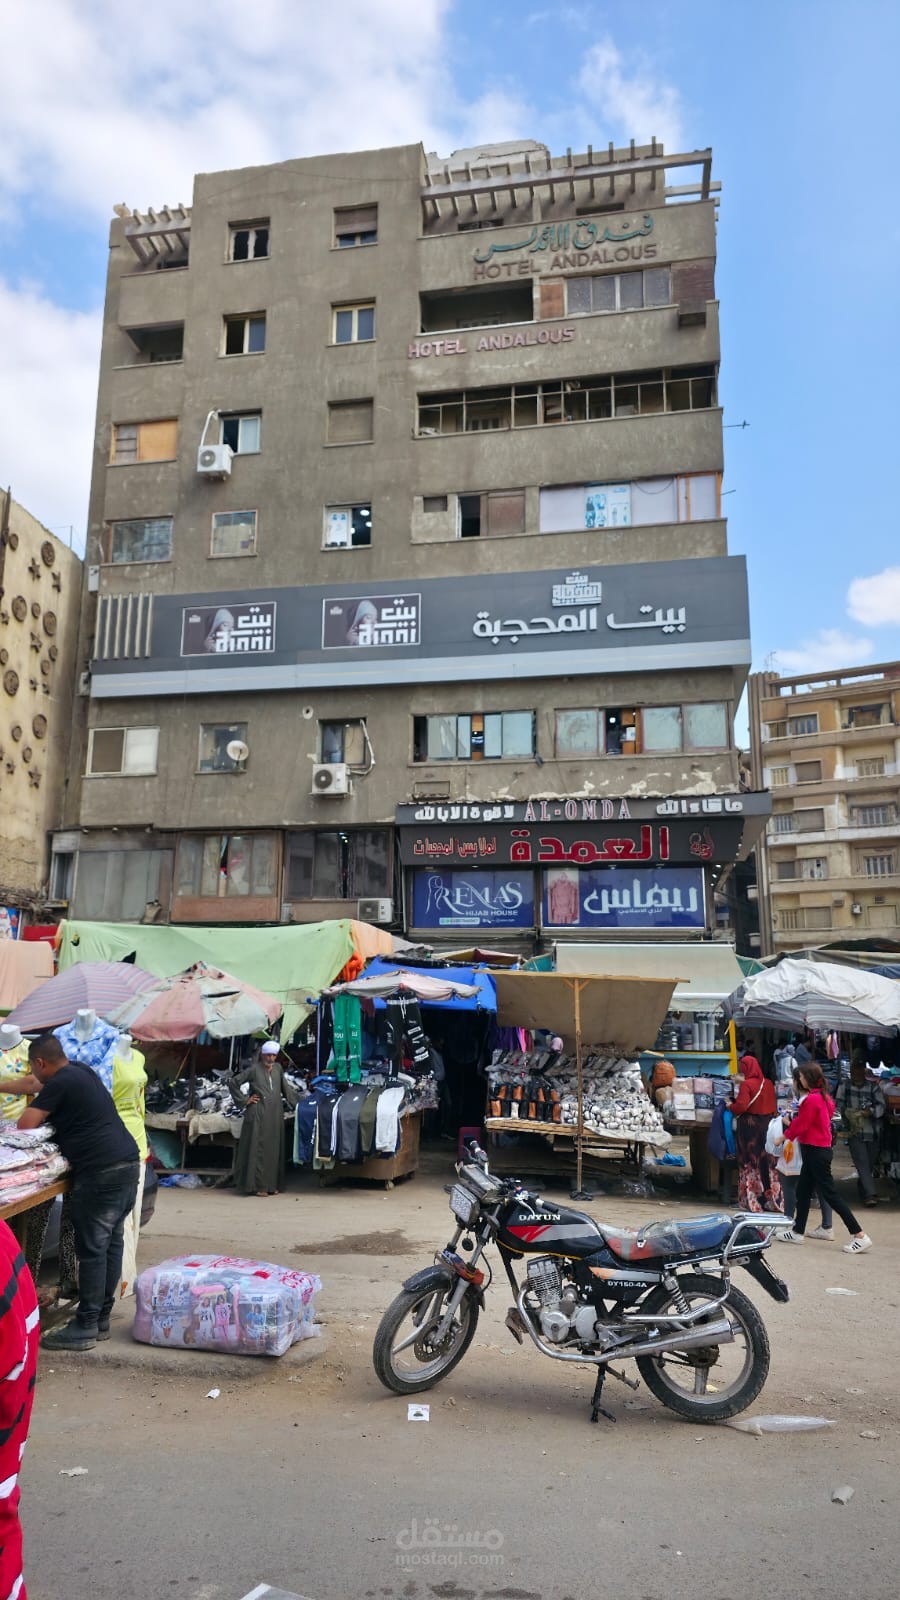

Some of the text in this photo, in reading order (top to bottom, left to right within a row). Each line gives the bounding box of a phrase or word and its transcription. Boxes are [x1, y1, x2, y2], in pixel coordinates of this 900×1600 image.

[573, 213, 655, 250] فندق
[473, 243, 657, 281] HOTEL ANDALOUS
[408, 327, 576, 359] HOTEL ANDALOUS
[472, 604, 686, 645] بيت المحجبة
[510, 825, 670, 864] العمدة
[583, 878, 698, 914] ريماس
